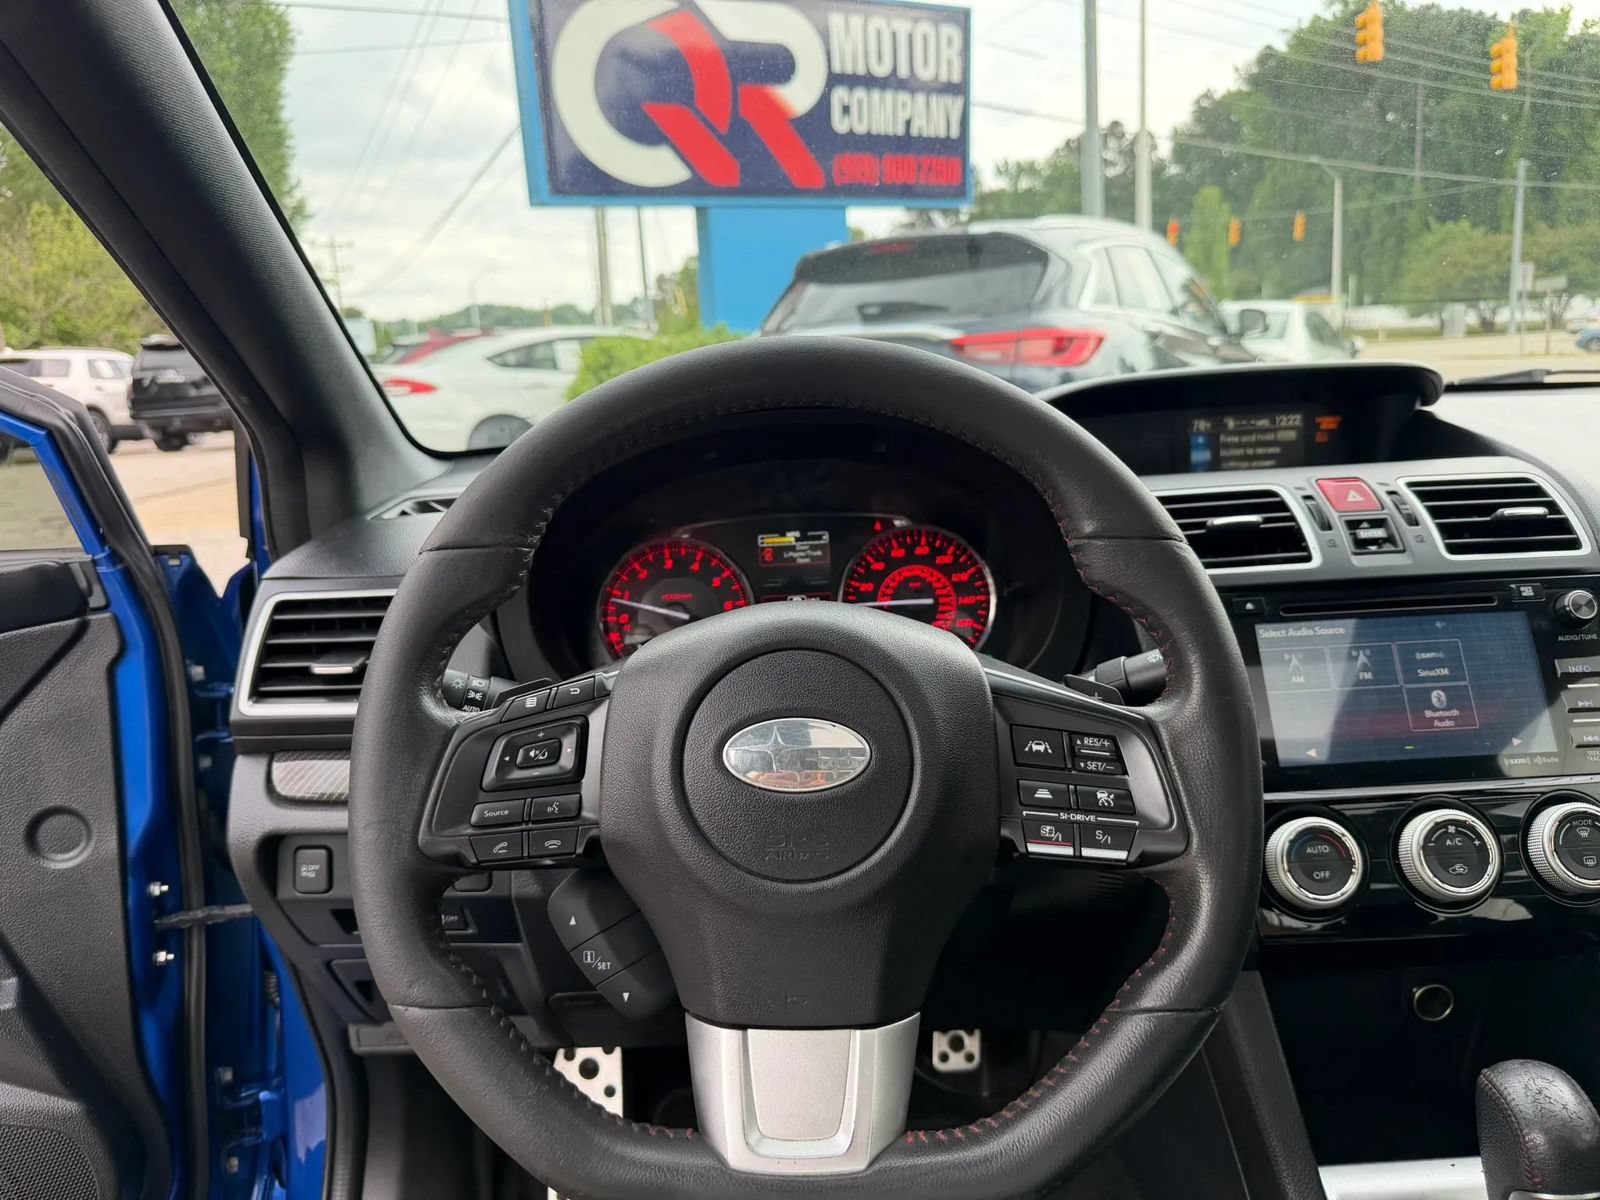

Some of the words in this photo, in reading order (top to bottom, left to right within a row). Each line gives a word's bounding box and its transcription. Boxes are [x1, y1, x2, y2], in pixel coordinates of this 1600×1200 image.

[827, 11, 963, 84] MOTOR
[829, 86, 965, 140] COMPANY
[1259, 628, 1287, 639] Select
[1287, 626, 1314, 637] Audio
[1314, 625, 1346, 635] Source
[1558, 633, 1598, 642] AUDIO/TUNE
[1568, 664, 1591, 674] INFO
[483, 809, 509, 818] Source
[1059, 812, 1096, 822] SI-DRIVE
[1572, 819, 1593, 827] MODE
[1445, 837, 1463, 847] A/C
[1305, 844, 1330, 855] AUTO
[1312, 870, 1331, 880] OFF
